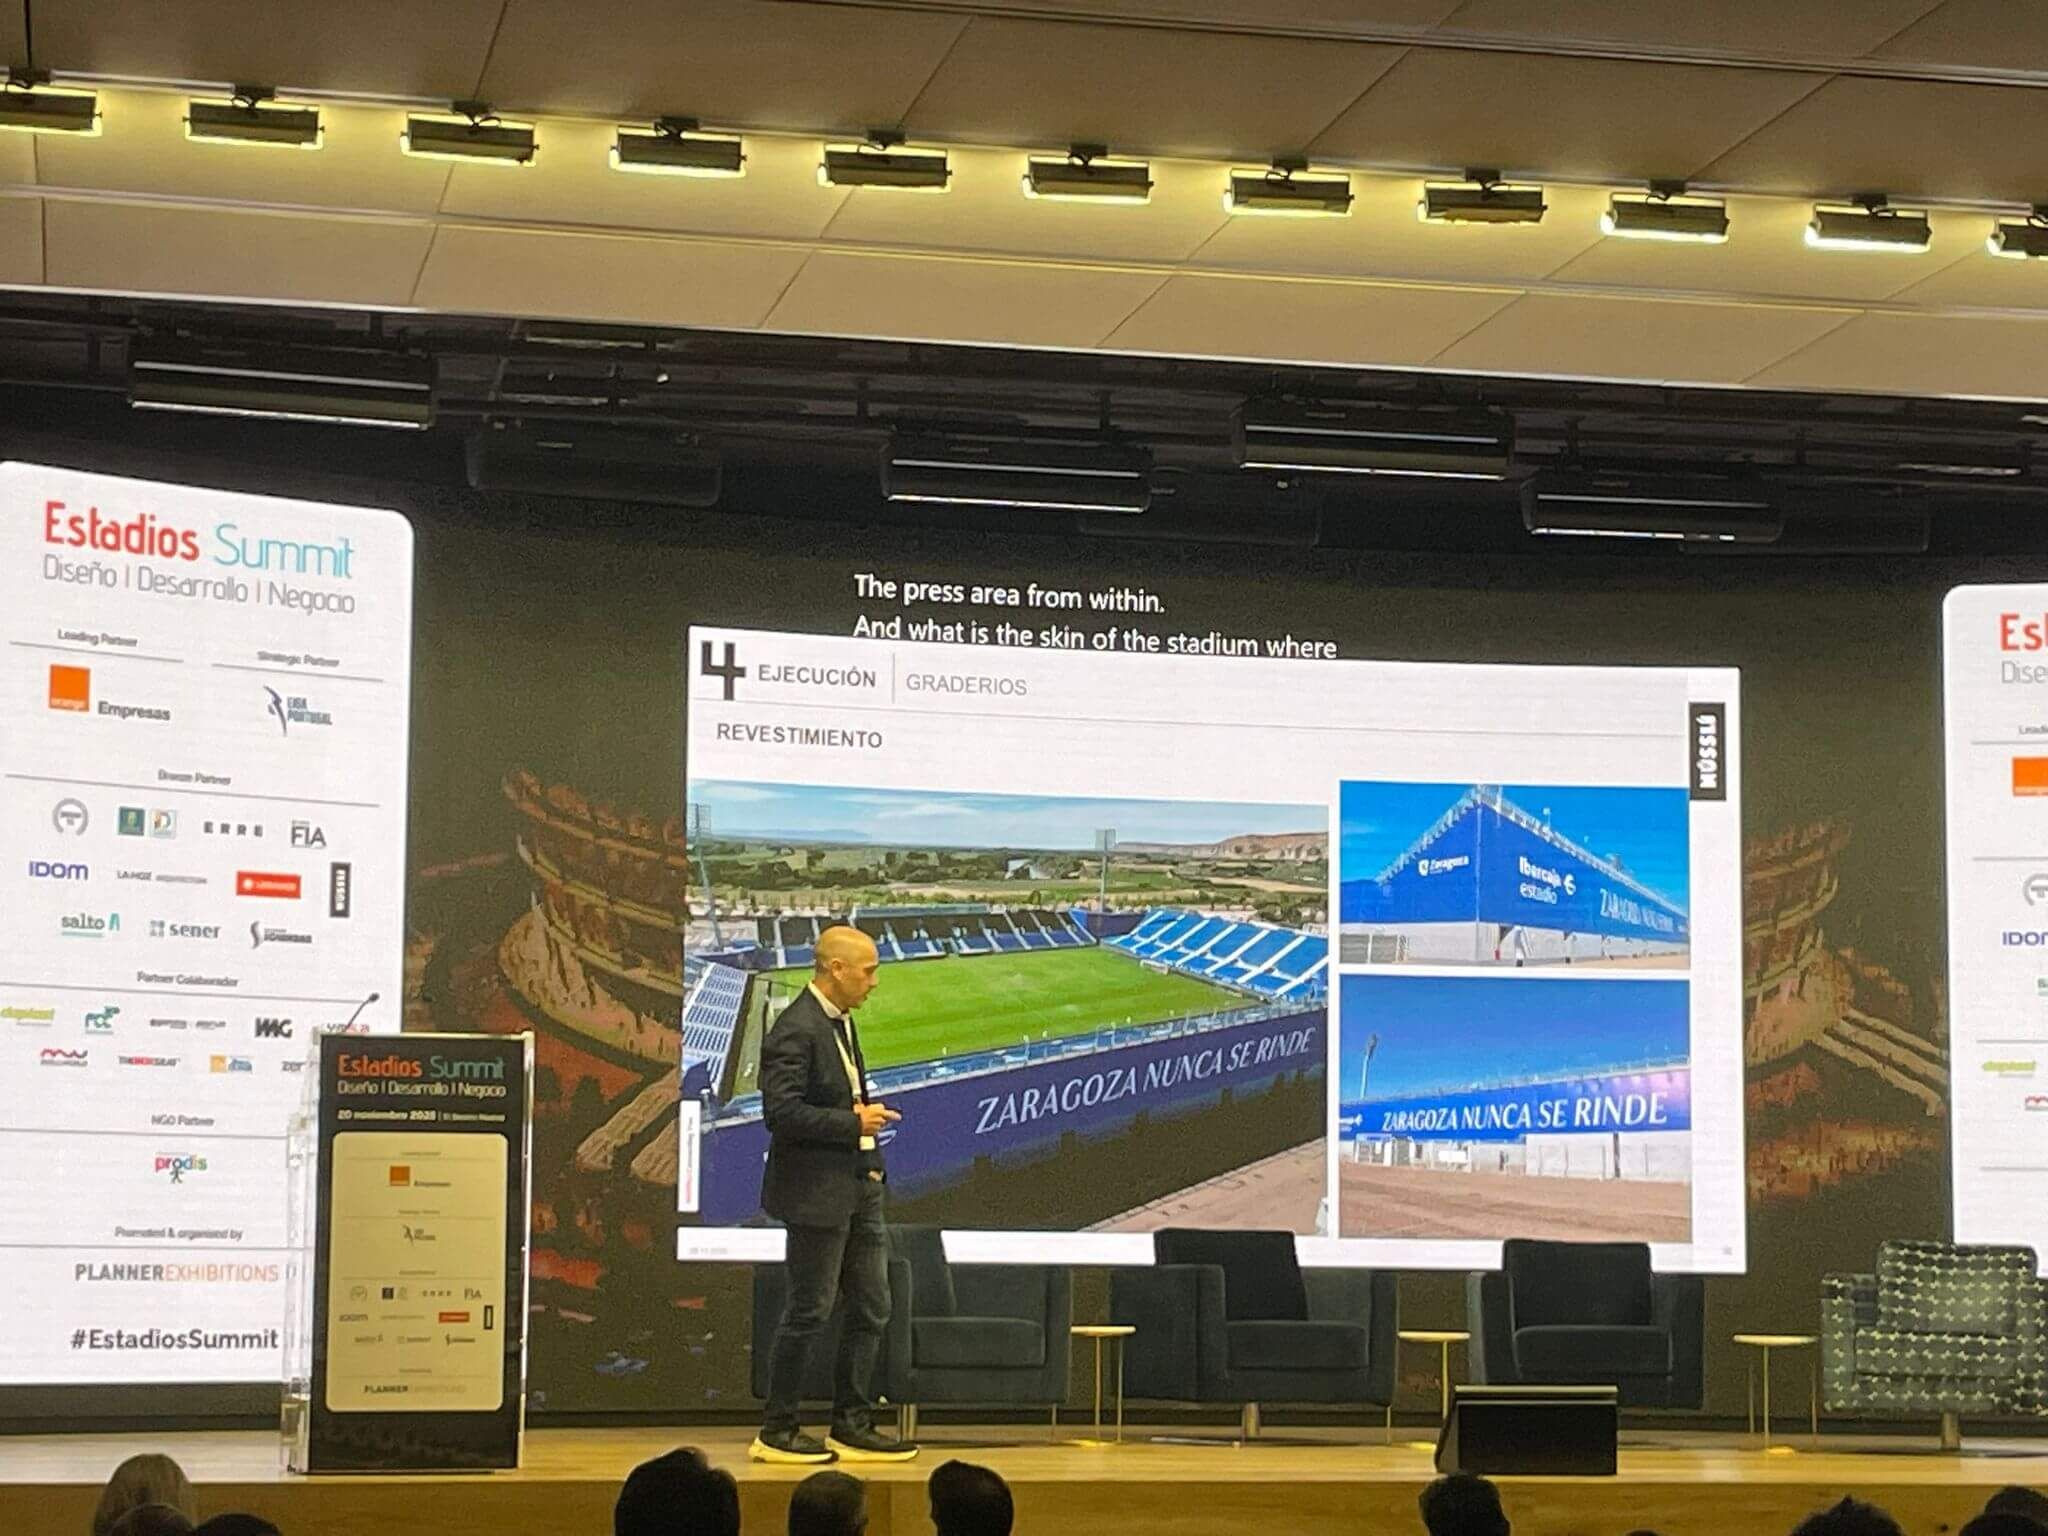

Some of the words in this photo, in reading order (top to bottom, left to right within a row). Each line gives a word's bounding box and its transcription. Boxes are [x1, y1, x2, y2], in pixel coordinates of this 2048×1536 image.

[45, 500, 200, 561] Estadios
[214, 522, 355, 579] Summit
[44, 553, 117, 588] Diseño
[138, 565, 248, 603] Desarrollo
[268, 580, 356, 616] Negocio
[854, 573, 897, 599] The
[903, 581, 965, 606] press
[970, 585, 1020, 606] area
[1027, 583, 1082, 609] from
[1089, 587, 1165, 613] within.
[853, 614, 901, 639] And
[908, 618, 965, 643] what
[971, 620, 989, 644] is
[996, 622, 1033, 646] the
[1040, 624, 1085, 649] skin
[1092, 627, 1118, 649] of
[1123, 628, 1160, 652] the
[1167, 631, 1258, 656] stadium
[1267, 634, 1337, 659] where
[700, 640, 746, 701] 4
[758, 664, 877, 688] EJECUCIÓN
[906, 673, 1028, 696] GRADERIOS
[98, 700, 170, 721] Empresas
[716, 722, 883, 748] REVESTIMIENTO
[291, 826, 327, 847] FIA
[61, 913, 105, 930] salto
[169, 922, 221, 939] sener
[338, 1054, 423, 1077] Estadios
[430, 1055, 504, 1079] Summit
[337, 1081, 378, 1095] Diseño
[388, 1081, 449, 1096] Desarrollo
[974, 1067, 1137, 1134] ZARAGOZA
[1142, 1050, 1222, 1093] NUNCA
[1226, 1039, 1252, 1072] SE
[1255, 1027, 1316, 1066] RINDE
[1382, 1109, 1457, 1132] ZARAGOZA
[1461, 1102, 1532, 1130] NUNCA
[1537, 1098, 1568, 1128] SE
[1574, 1091, 1668, 1127] RINDE
[155, 1154, 207, 1173] prodis
[71, 1328, 279, 1350] #EstadiosSummit
